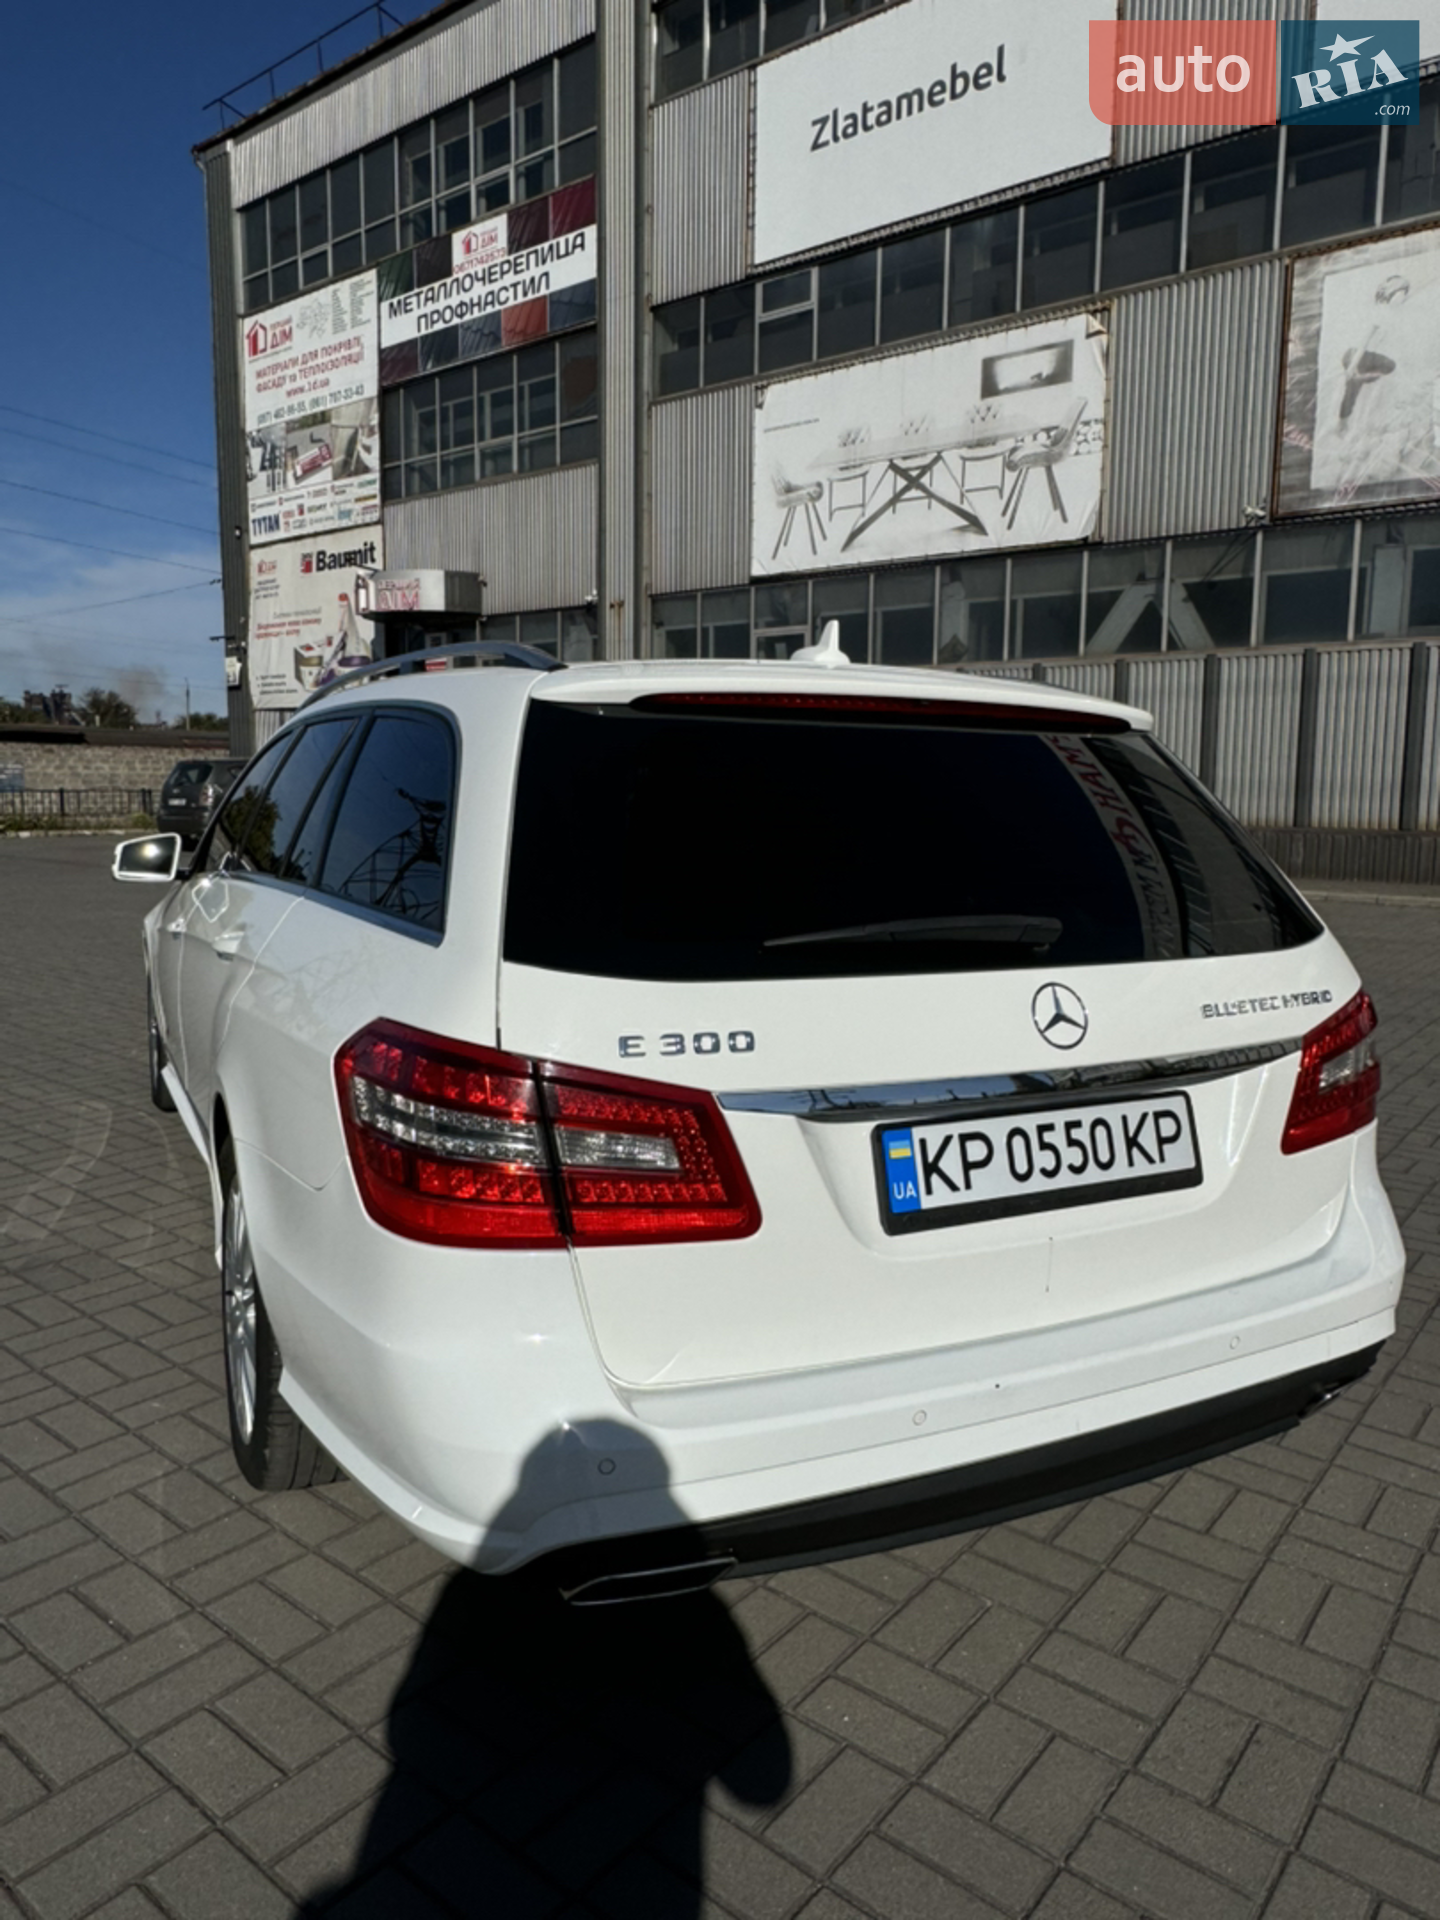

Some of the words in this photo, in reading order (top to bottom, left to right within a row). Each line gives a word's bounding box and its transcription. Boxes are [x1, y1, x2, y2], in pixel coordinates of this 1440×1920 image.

[810, 43, 1006, 152] Zlatamebel
[388, 231, 586, 320] МЕТАЛЛОЧЕРЕПИЦА
[417, 271, 550, 334] ПРОФНАСТИЛ
[252, 512, 280, 537] TYTAN
[316, 541, 376, 572] Baumit
[1281, 989, 1333, 1009] HYBRID
[618, 1035, 646, 1058] E
[659, 1031, 756, 1056] 300
[918, 1131, 995, 1196] KP
[1005, 1117, 1116, 1183] 0550
[1121, 1109, 1182, 1168] KP
[892, 1180, 917, 1200] UA
